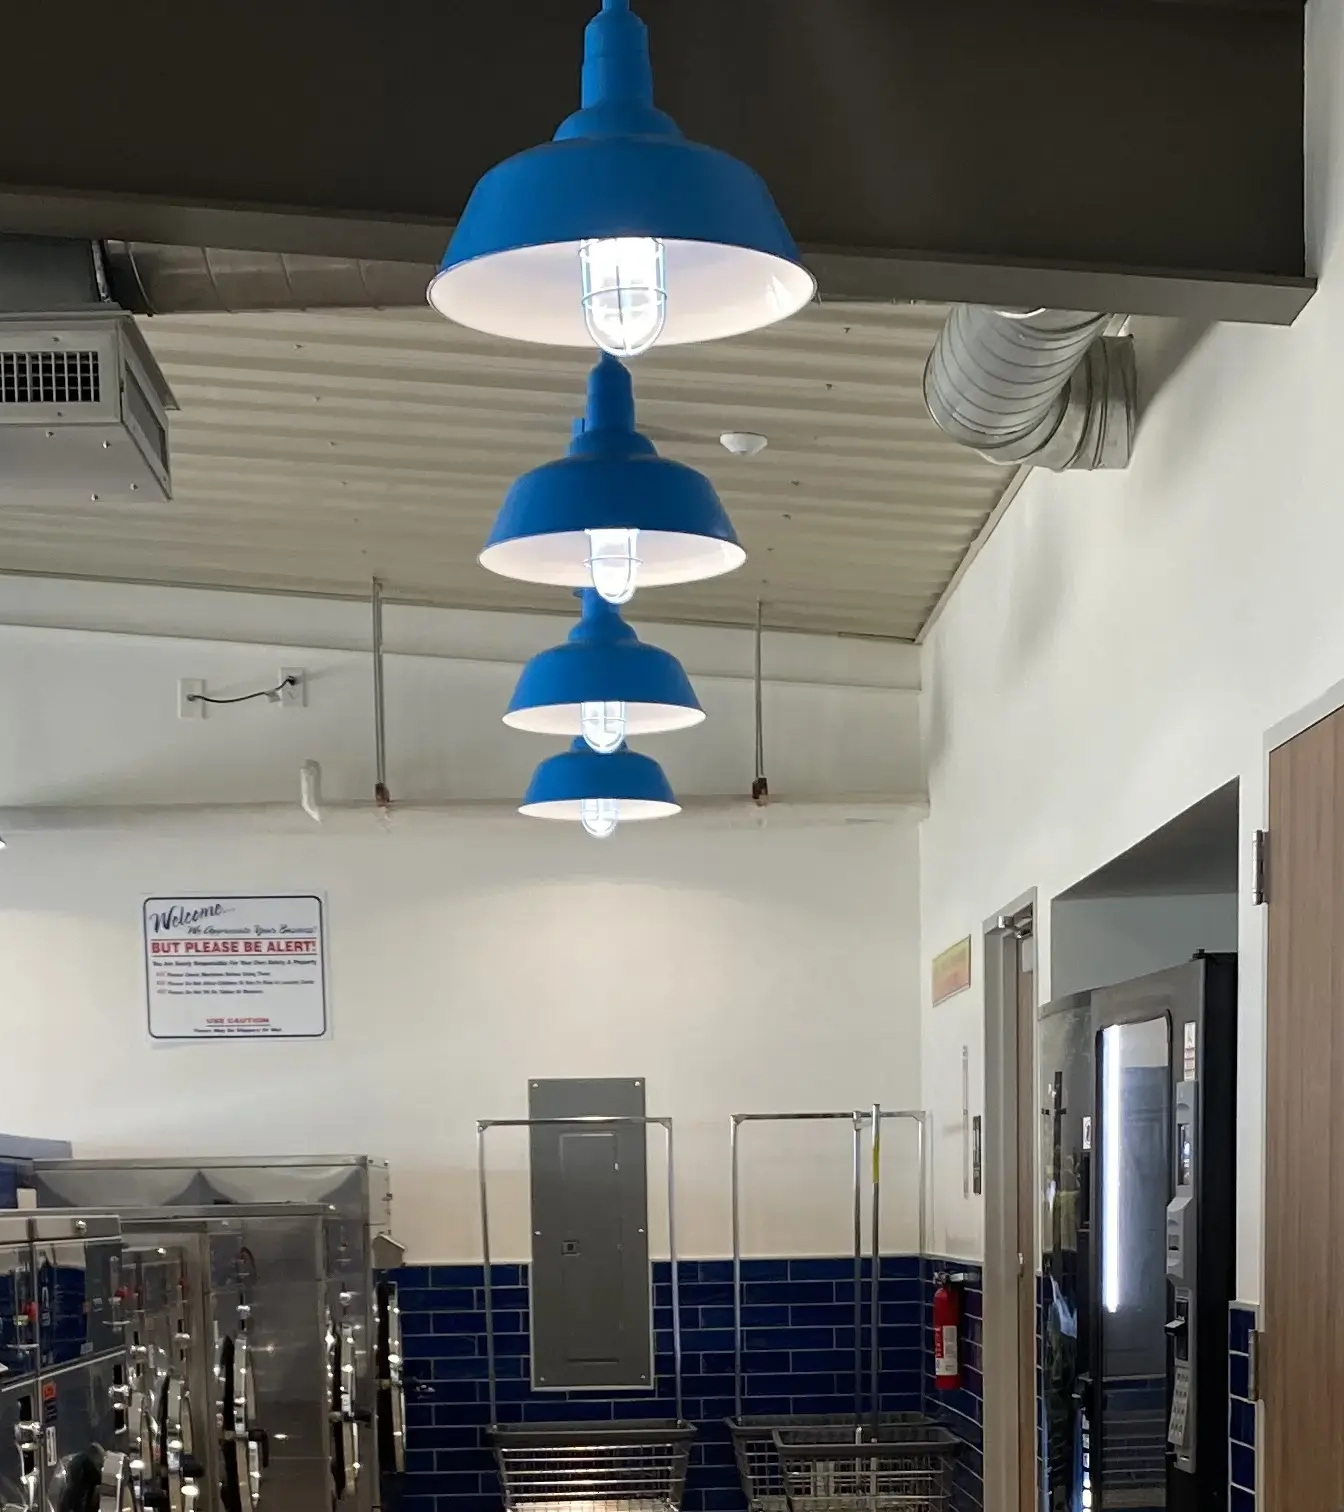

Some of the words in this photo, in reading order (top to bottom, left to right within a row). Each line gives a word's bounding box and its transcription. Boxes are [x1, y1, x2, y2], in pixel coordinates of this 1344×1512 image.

[151, 942, 181, 954] BUT
[184, 941, 239, 953] PLEASE
[244, 941, 262, 953] BE
[267, 940, 317, 953] ALERT!
